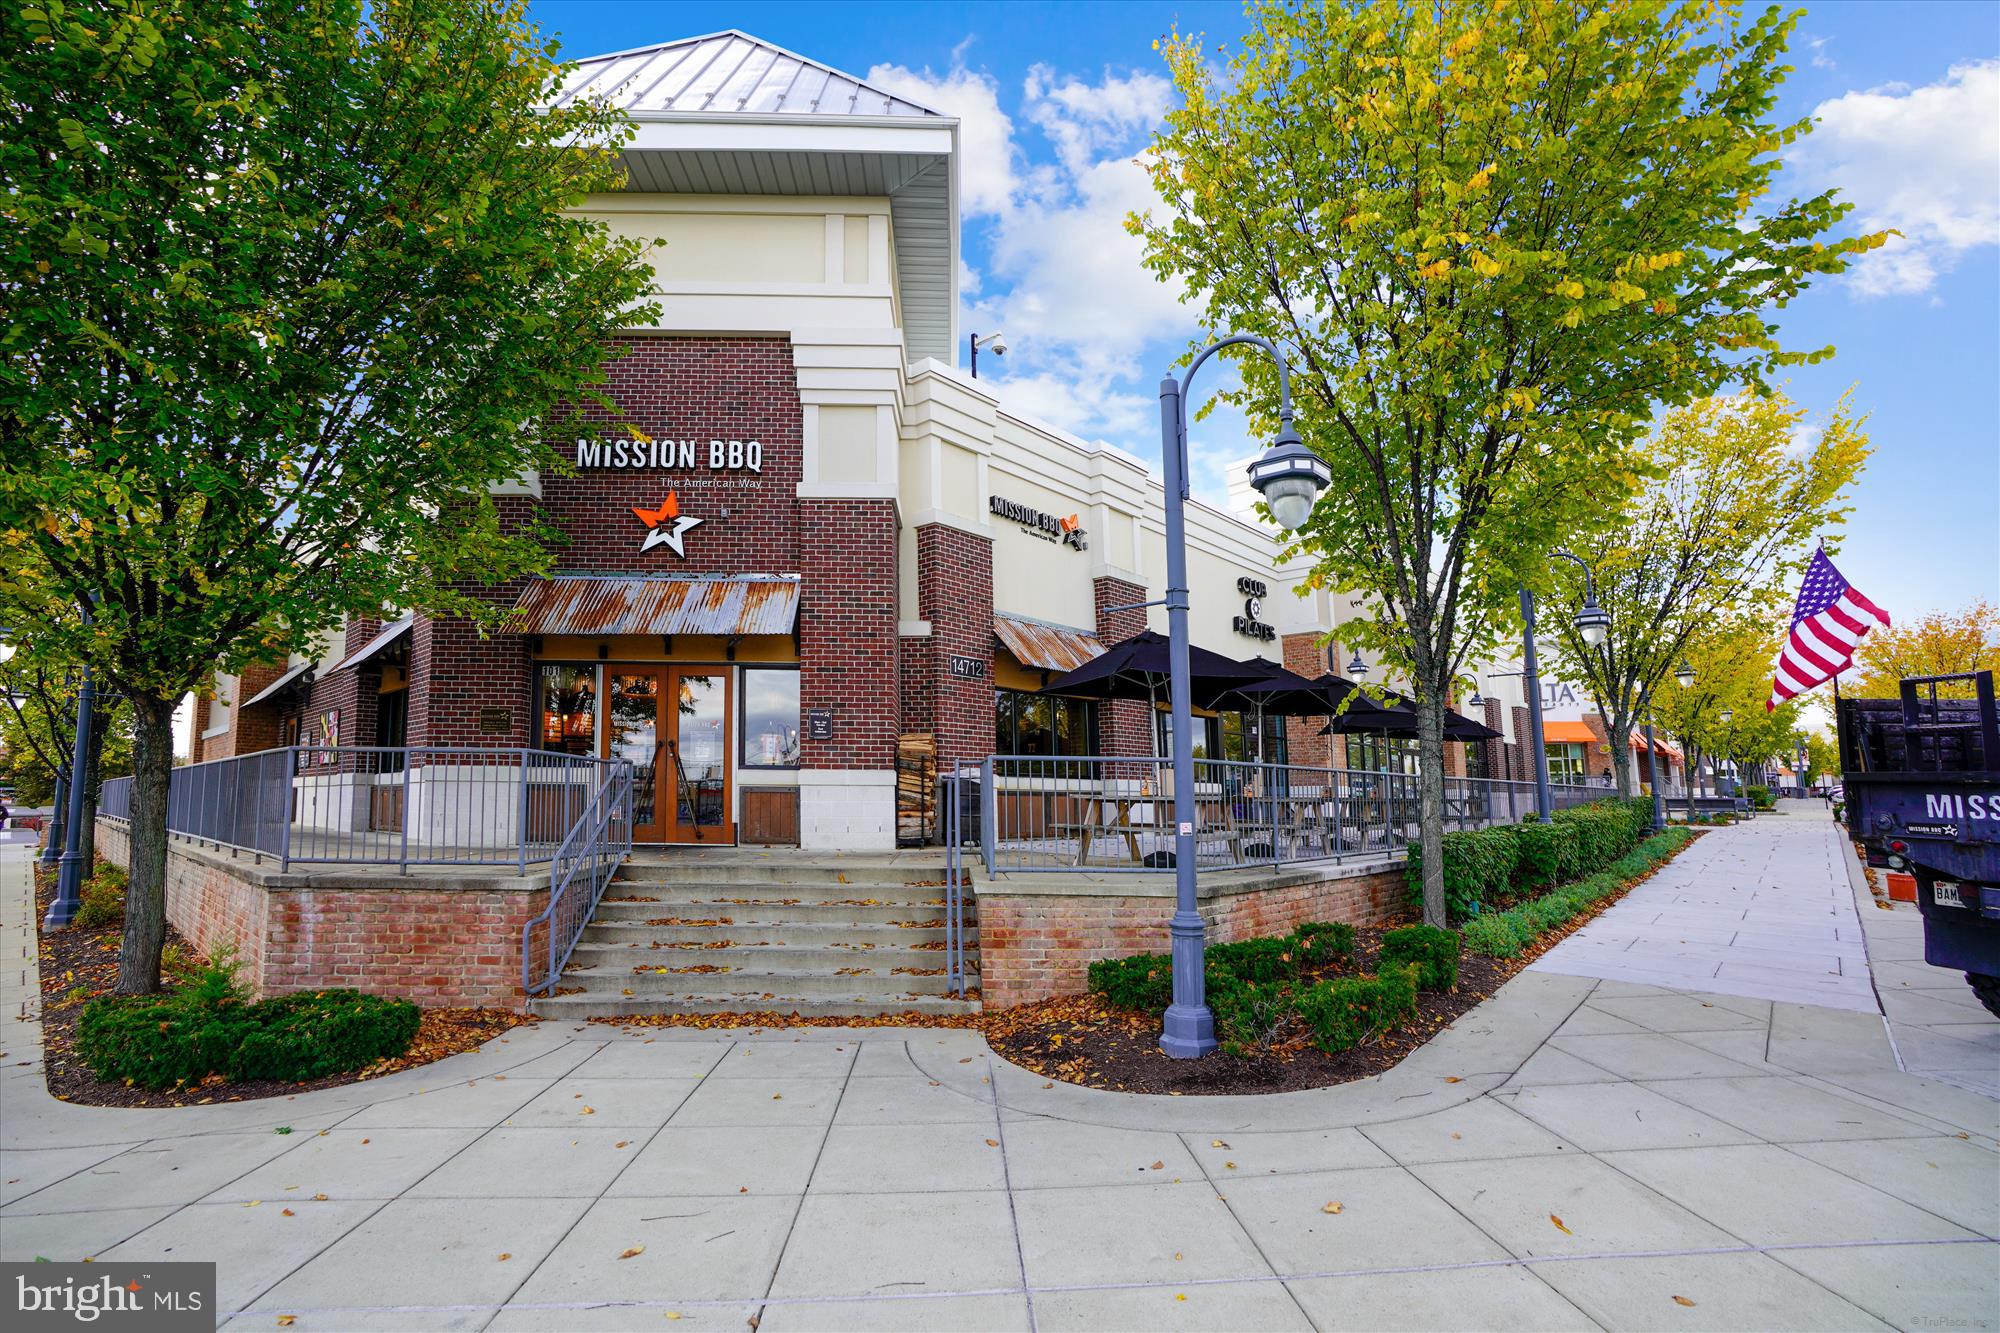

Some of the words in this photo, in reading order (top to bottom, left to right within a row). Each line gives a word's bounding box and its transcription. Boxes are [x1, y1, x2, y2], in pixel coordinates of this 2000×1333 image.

[577, 439, 696, 469] MISSION
[709, 440, 763, 473] BBQ
[661, 477, 680, 487] The
[684, 478, 735, 488] American
[739, 479, 762, 489] Way
[992, 496, 1039, 526] MISSION
[1040, 513, 1061, 535] BBQ
[1020, 527, 1029, 535] The
[1029, 531, 1048, 541] American
[1239, 576, 1267, 597] CLUB
[1235, 616, 1276, 641] PILATES
[542, 666, 559, 676] 101
[952, 658, 983, 677] 14712
[1925, 794, 2000, 821] MISS
